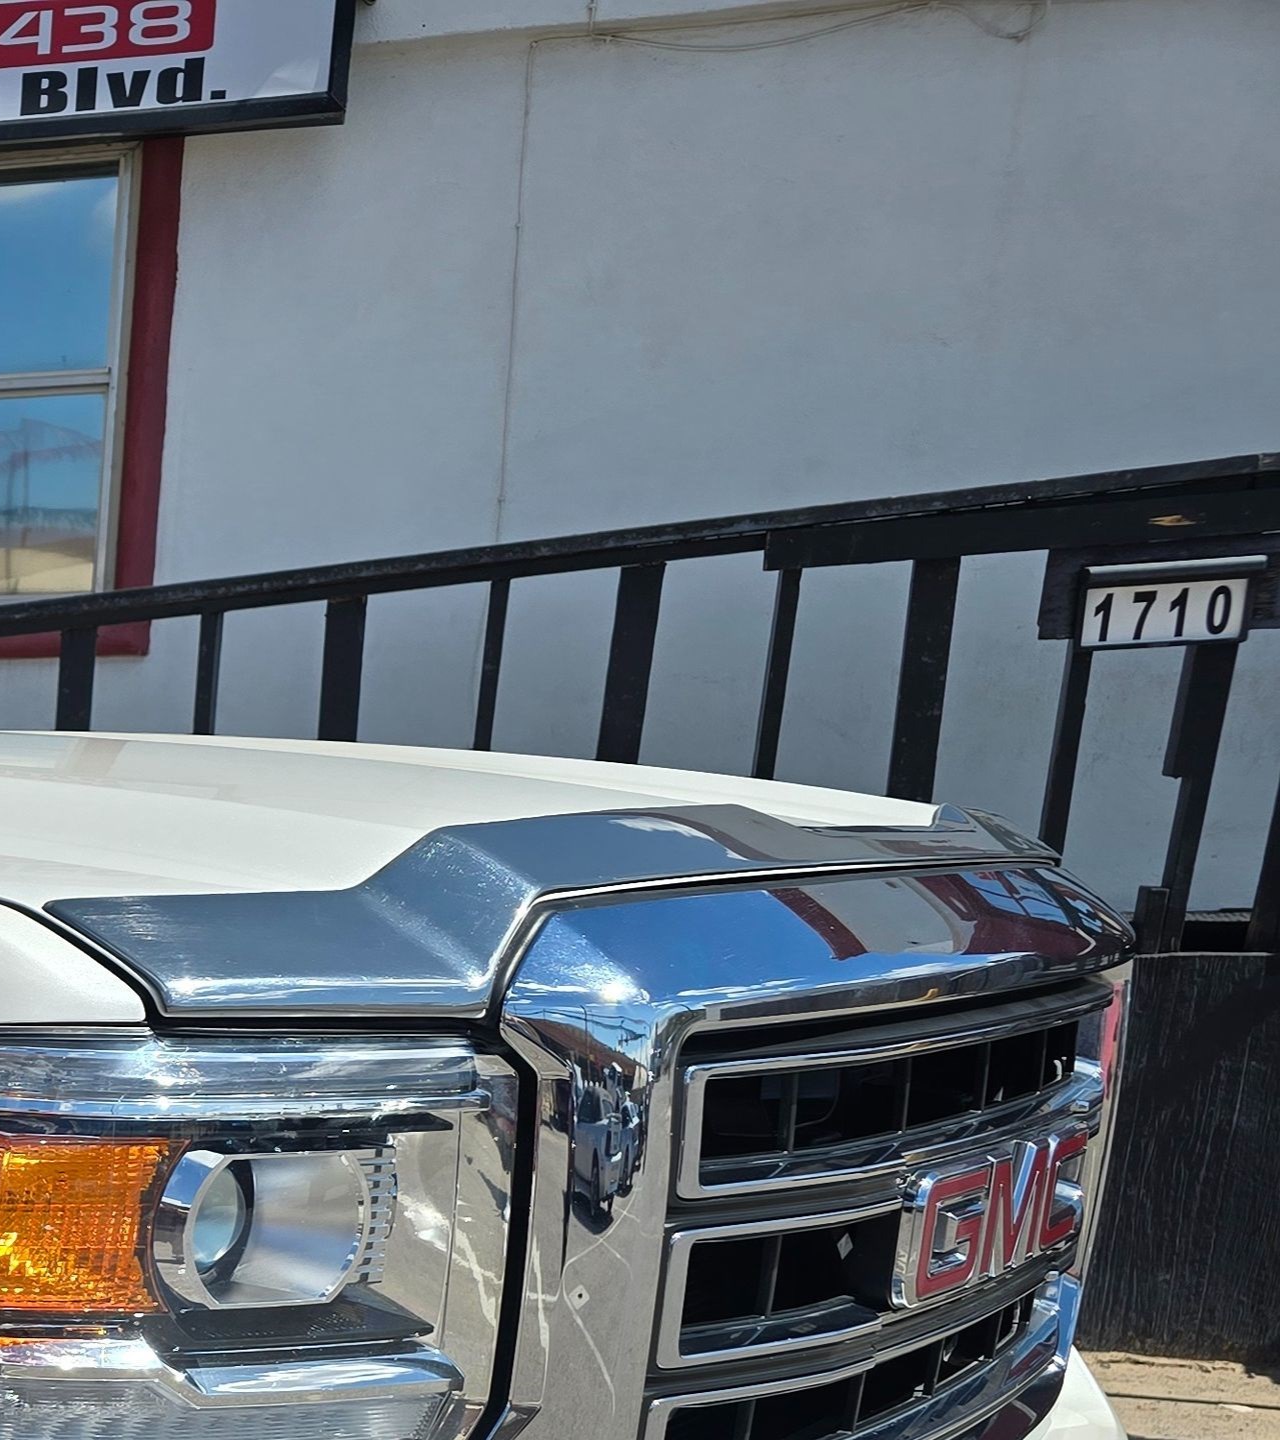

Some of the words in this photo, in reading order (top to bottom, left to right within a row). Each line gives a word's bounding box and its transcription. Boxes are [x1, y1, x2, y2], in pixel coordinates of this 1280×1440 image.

[20, 57, 226, 116] Blvd.
[1093, 585, 1232, 642] 1710
[898, 1121, 1090, 1306] GMC
